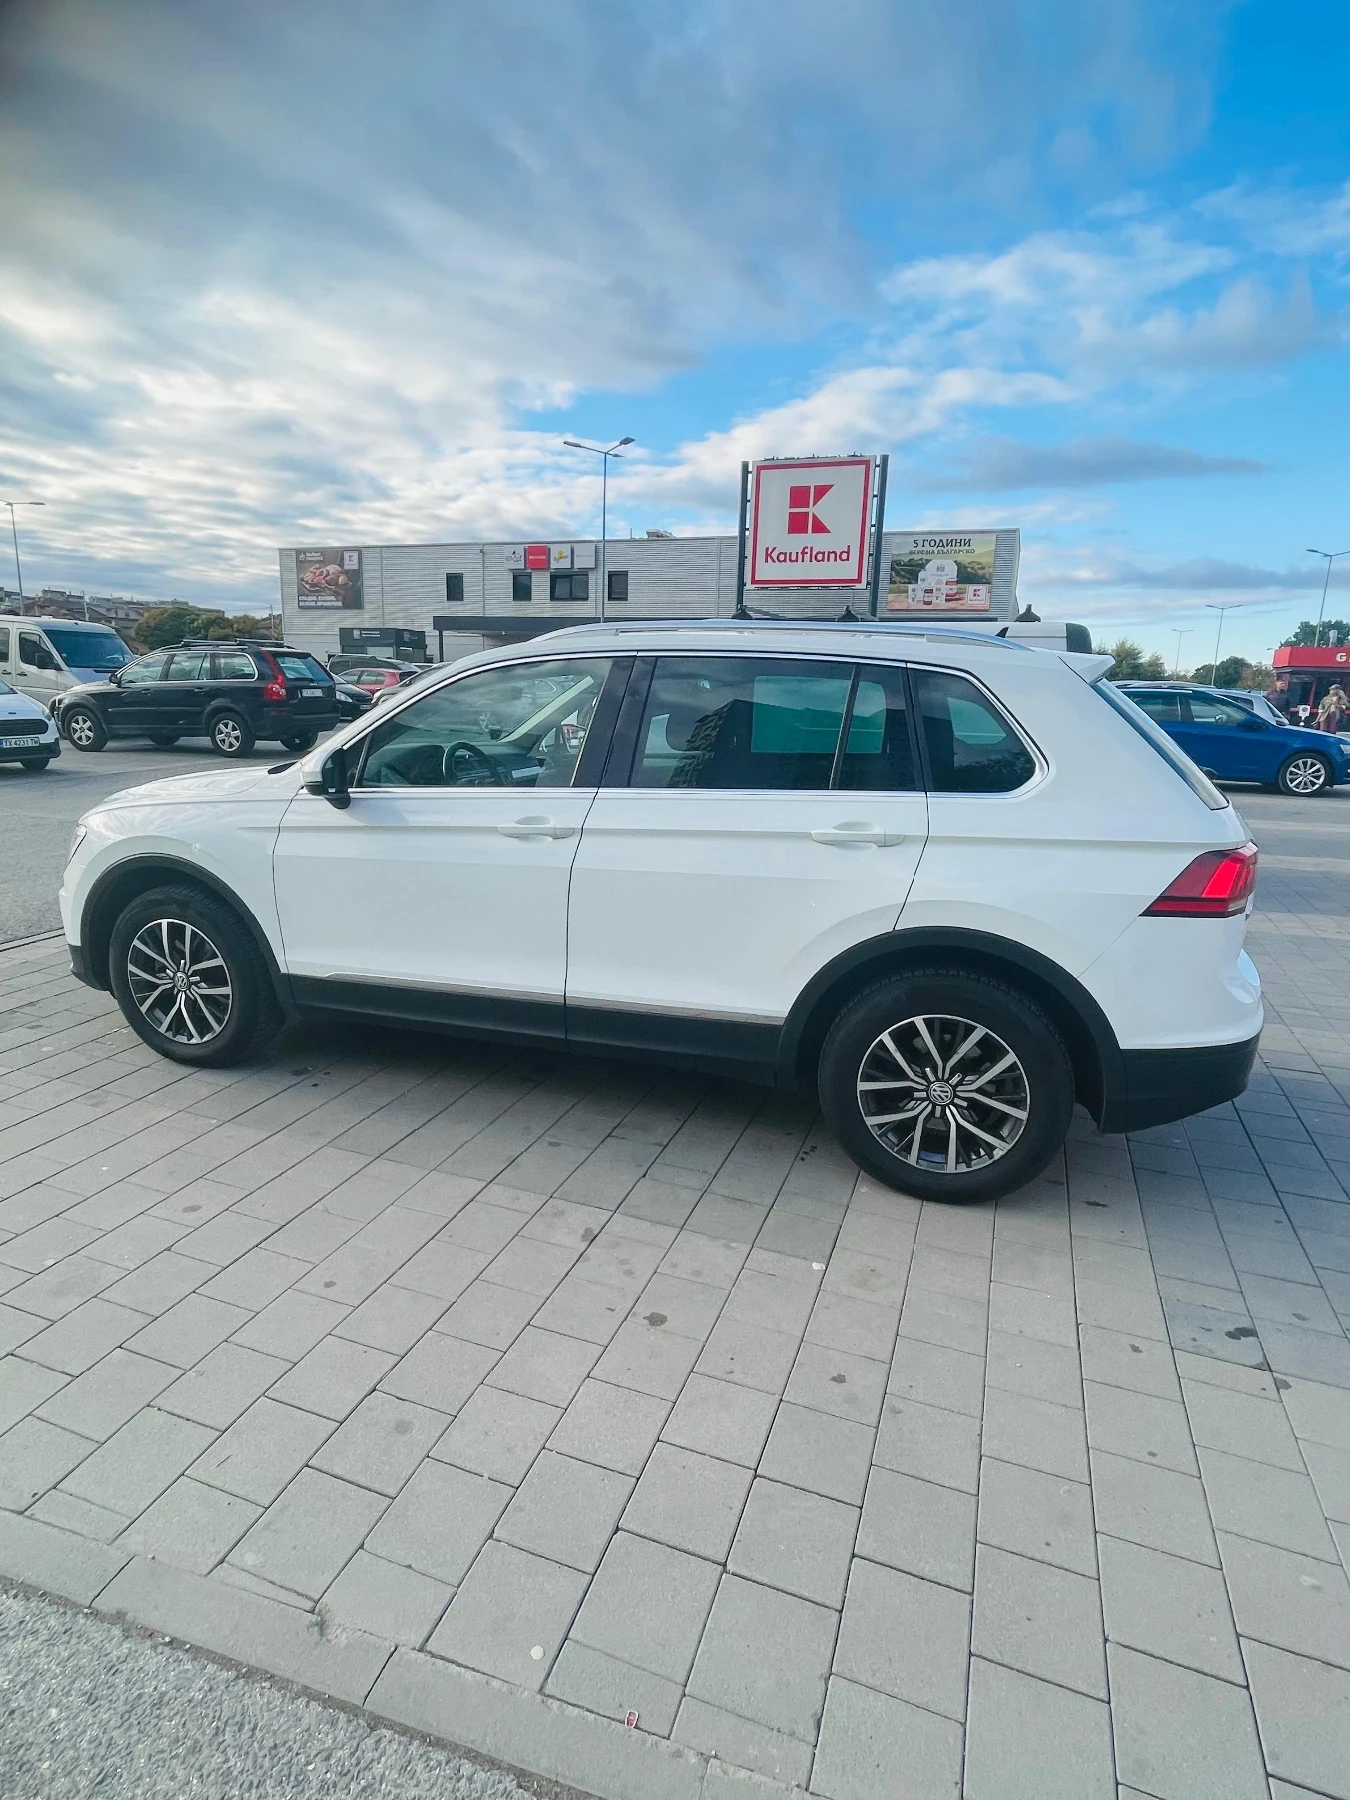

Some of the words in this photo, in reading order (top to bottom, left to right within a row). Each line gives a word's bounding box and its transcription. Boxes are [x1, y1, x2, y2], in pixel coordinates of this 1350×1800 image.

[913, 539, 919, 548] 5
[921, 538, 972, 549] ГОДИНИ
[764, 545, 851, 564] Kaufland
